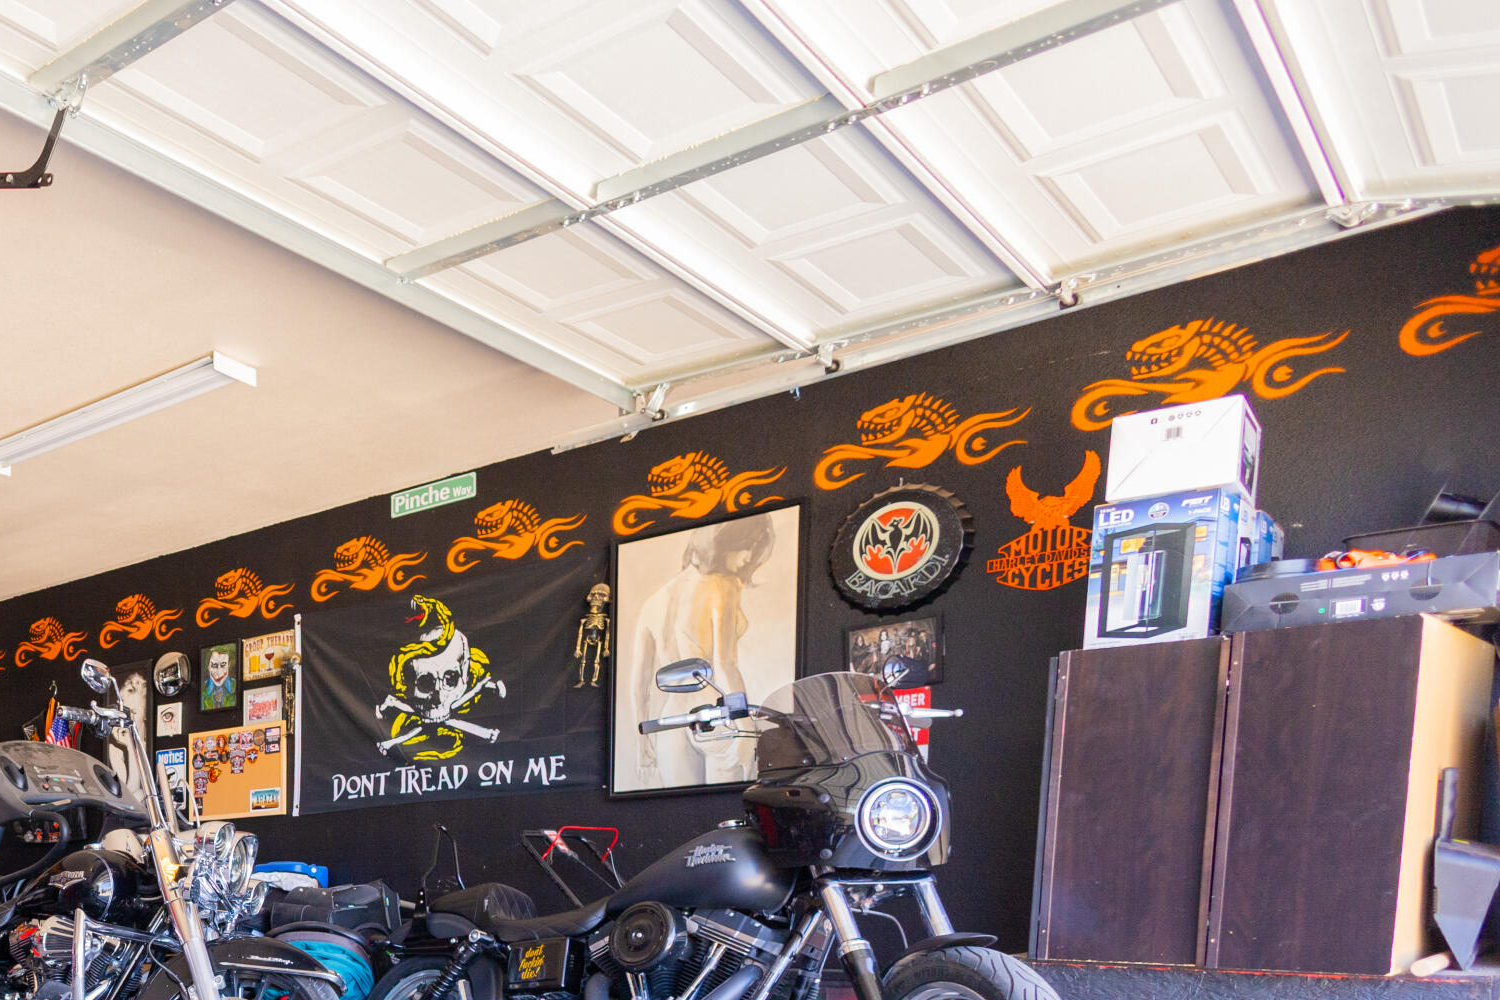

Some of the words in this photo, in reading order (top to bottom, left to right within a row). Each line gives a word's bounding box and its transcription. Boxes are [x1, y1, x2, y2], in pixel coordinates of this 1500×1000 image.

[395, 486, 450, 513] Pinche
[453, 485, 472, 497] Way
[1098, 509, 1134, 526] LED
[1010, 528, 1090, 558] MOTOR
[993, 555, 1039, 570] HARLEY
[1047, 548, 1090, 562] DAVIDS
[1008, 559, 1088, 587] CYCLES
[845, 554, 948, 599] BACARDI
[245, 638, 263, 652] GROUP
[158, 751, 184, 765] NOTICE
[332, 771, 390, 801] DONT
[395, 764, 469, 796] TREAD
[478, 760, 514, 787] ON
[523, 755, 567, 786] ME
